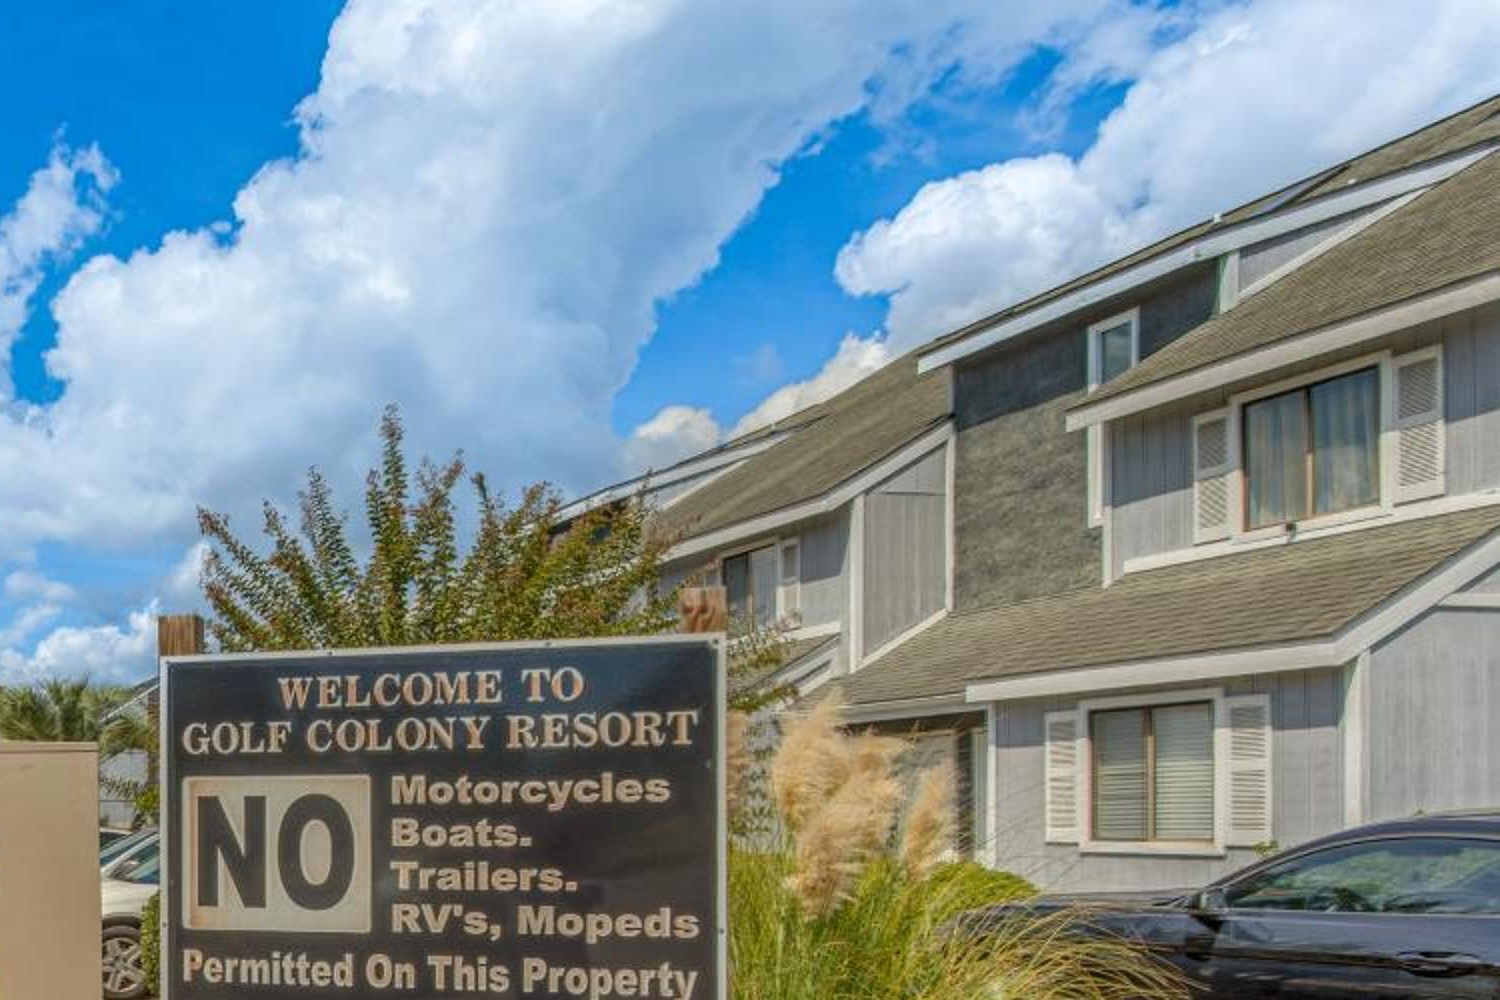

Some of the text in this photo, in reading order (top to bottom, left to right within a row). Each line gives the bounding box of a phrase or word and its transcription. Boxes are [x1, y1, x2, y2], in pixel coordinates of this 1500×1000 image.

[277, 666, 585, 709] WELCOME TO
[182, 710, 699, 755] GOLF COLONY RESORT
[390, 772, 672, 811] Motorcycles
[196, 793, 355, 912] NO
[391, 903, 701, 944] RV's, Mopeds
[182, 949, 354, 989] Permitted
[365, 954, 416, 989] On
[427, 955, 510, 993] This
